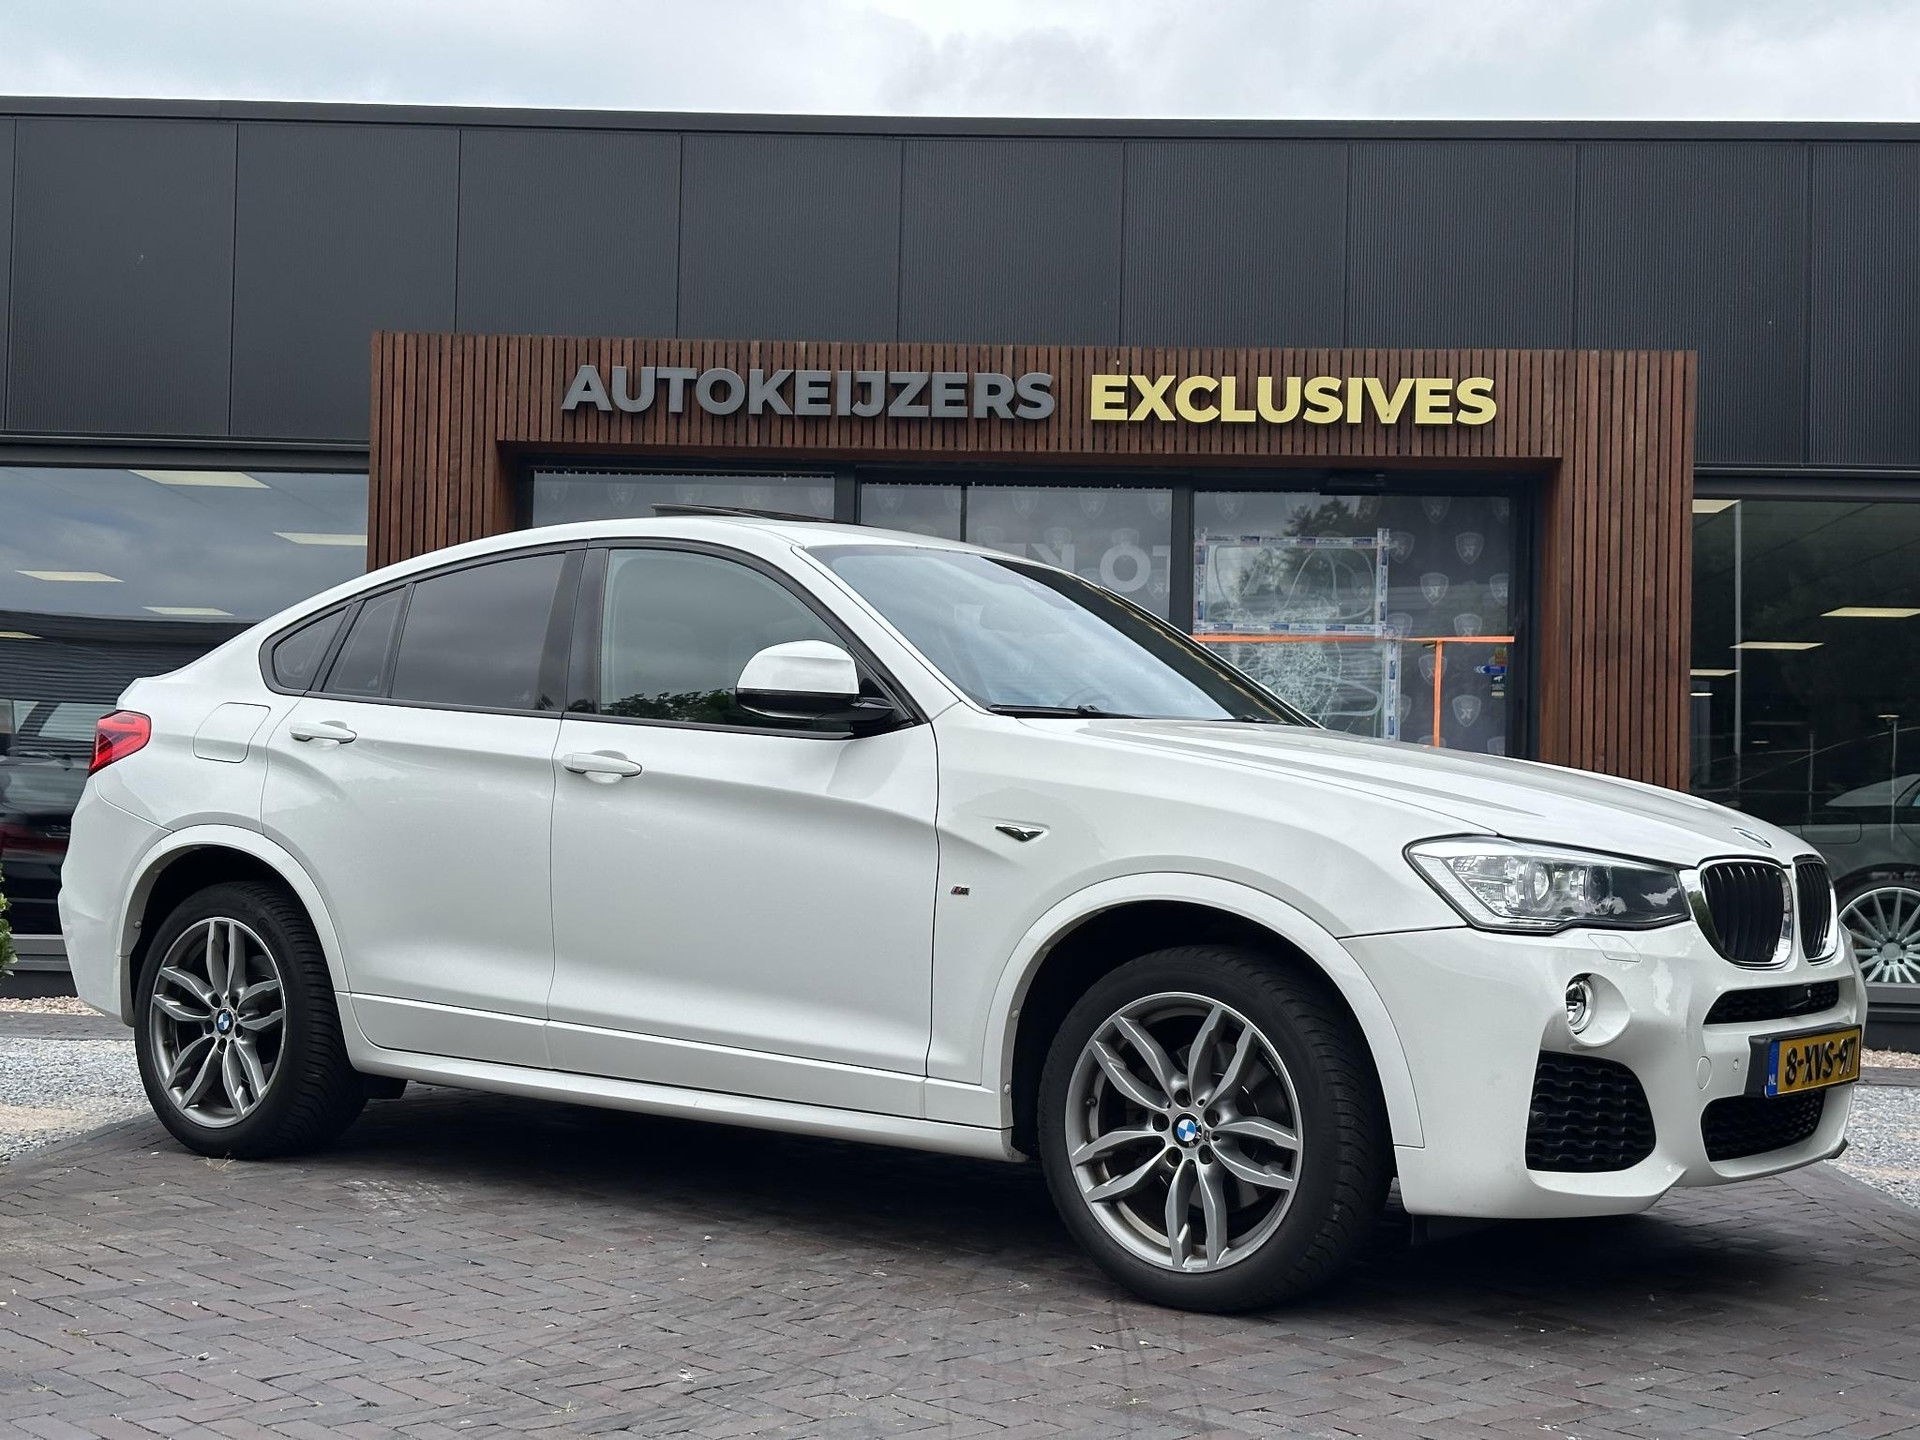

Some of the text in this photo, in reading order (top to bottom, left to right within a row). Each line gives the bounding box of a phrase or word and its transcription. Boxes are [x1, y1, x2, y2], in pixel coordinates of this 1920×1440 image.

[561, 365, 1498, 425] AUTOKEIJZERS EXCLUSIVES
[1767, 1074, 1777, 1086] NL
[1785, 1037, 1857, 1086] 8-XVS-97
